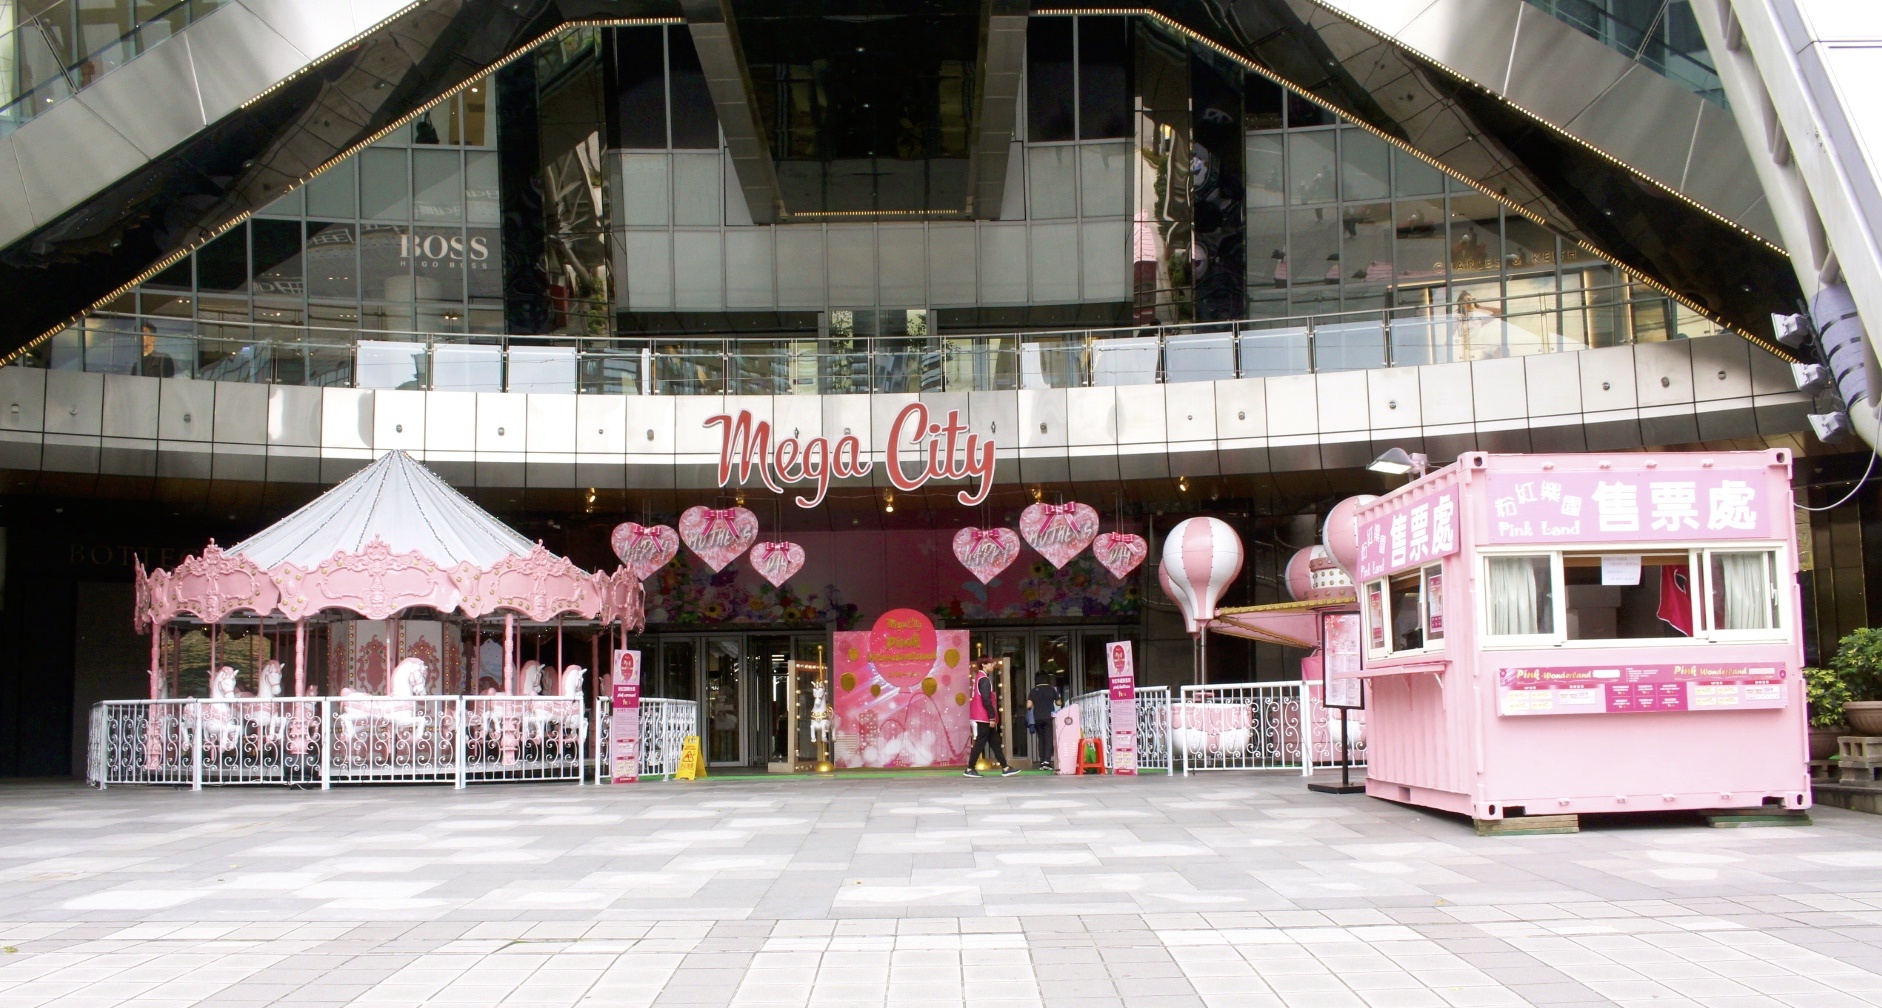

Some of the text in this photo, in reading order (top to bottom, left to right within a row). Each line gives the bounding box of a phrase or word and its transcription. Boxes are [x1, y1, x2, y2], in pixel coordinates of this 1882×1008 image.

[400, 235, 488, 260] BOSS
[1433, 258, 1500, 274] CARLES
[1513, 257, 1522, 266] &
[702, 402, 996, 508] Mega City
[1494, 480, 1757, 532] 粉紅樂園 售票處
[1390, 494, 1454, 568] 售票處
[1498, 520, 1580, 537] Pink Land
[1516, 669, 1591, 680] Pink Wonderland
[1674, 665, 1747, 676] Pink Wonderland
